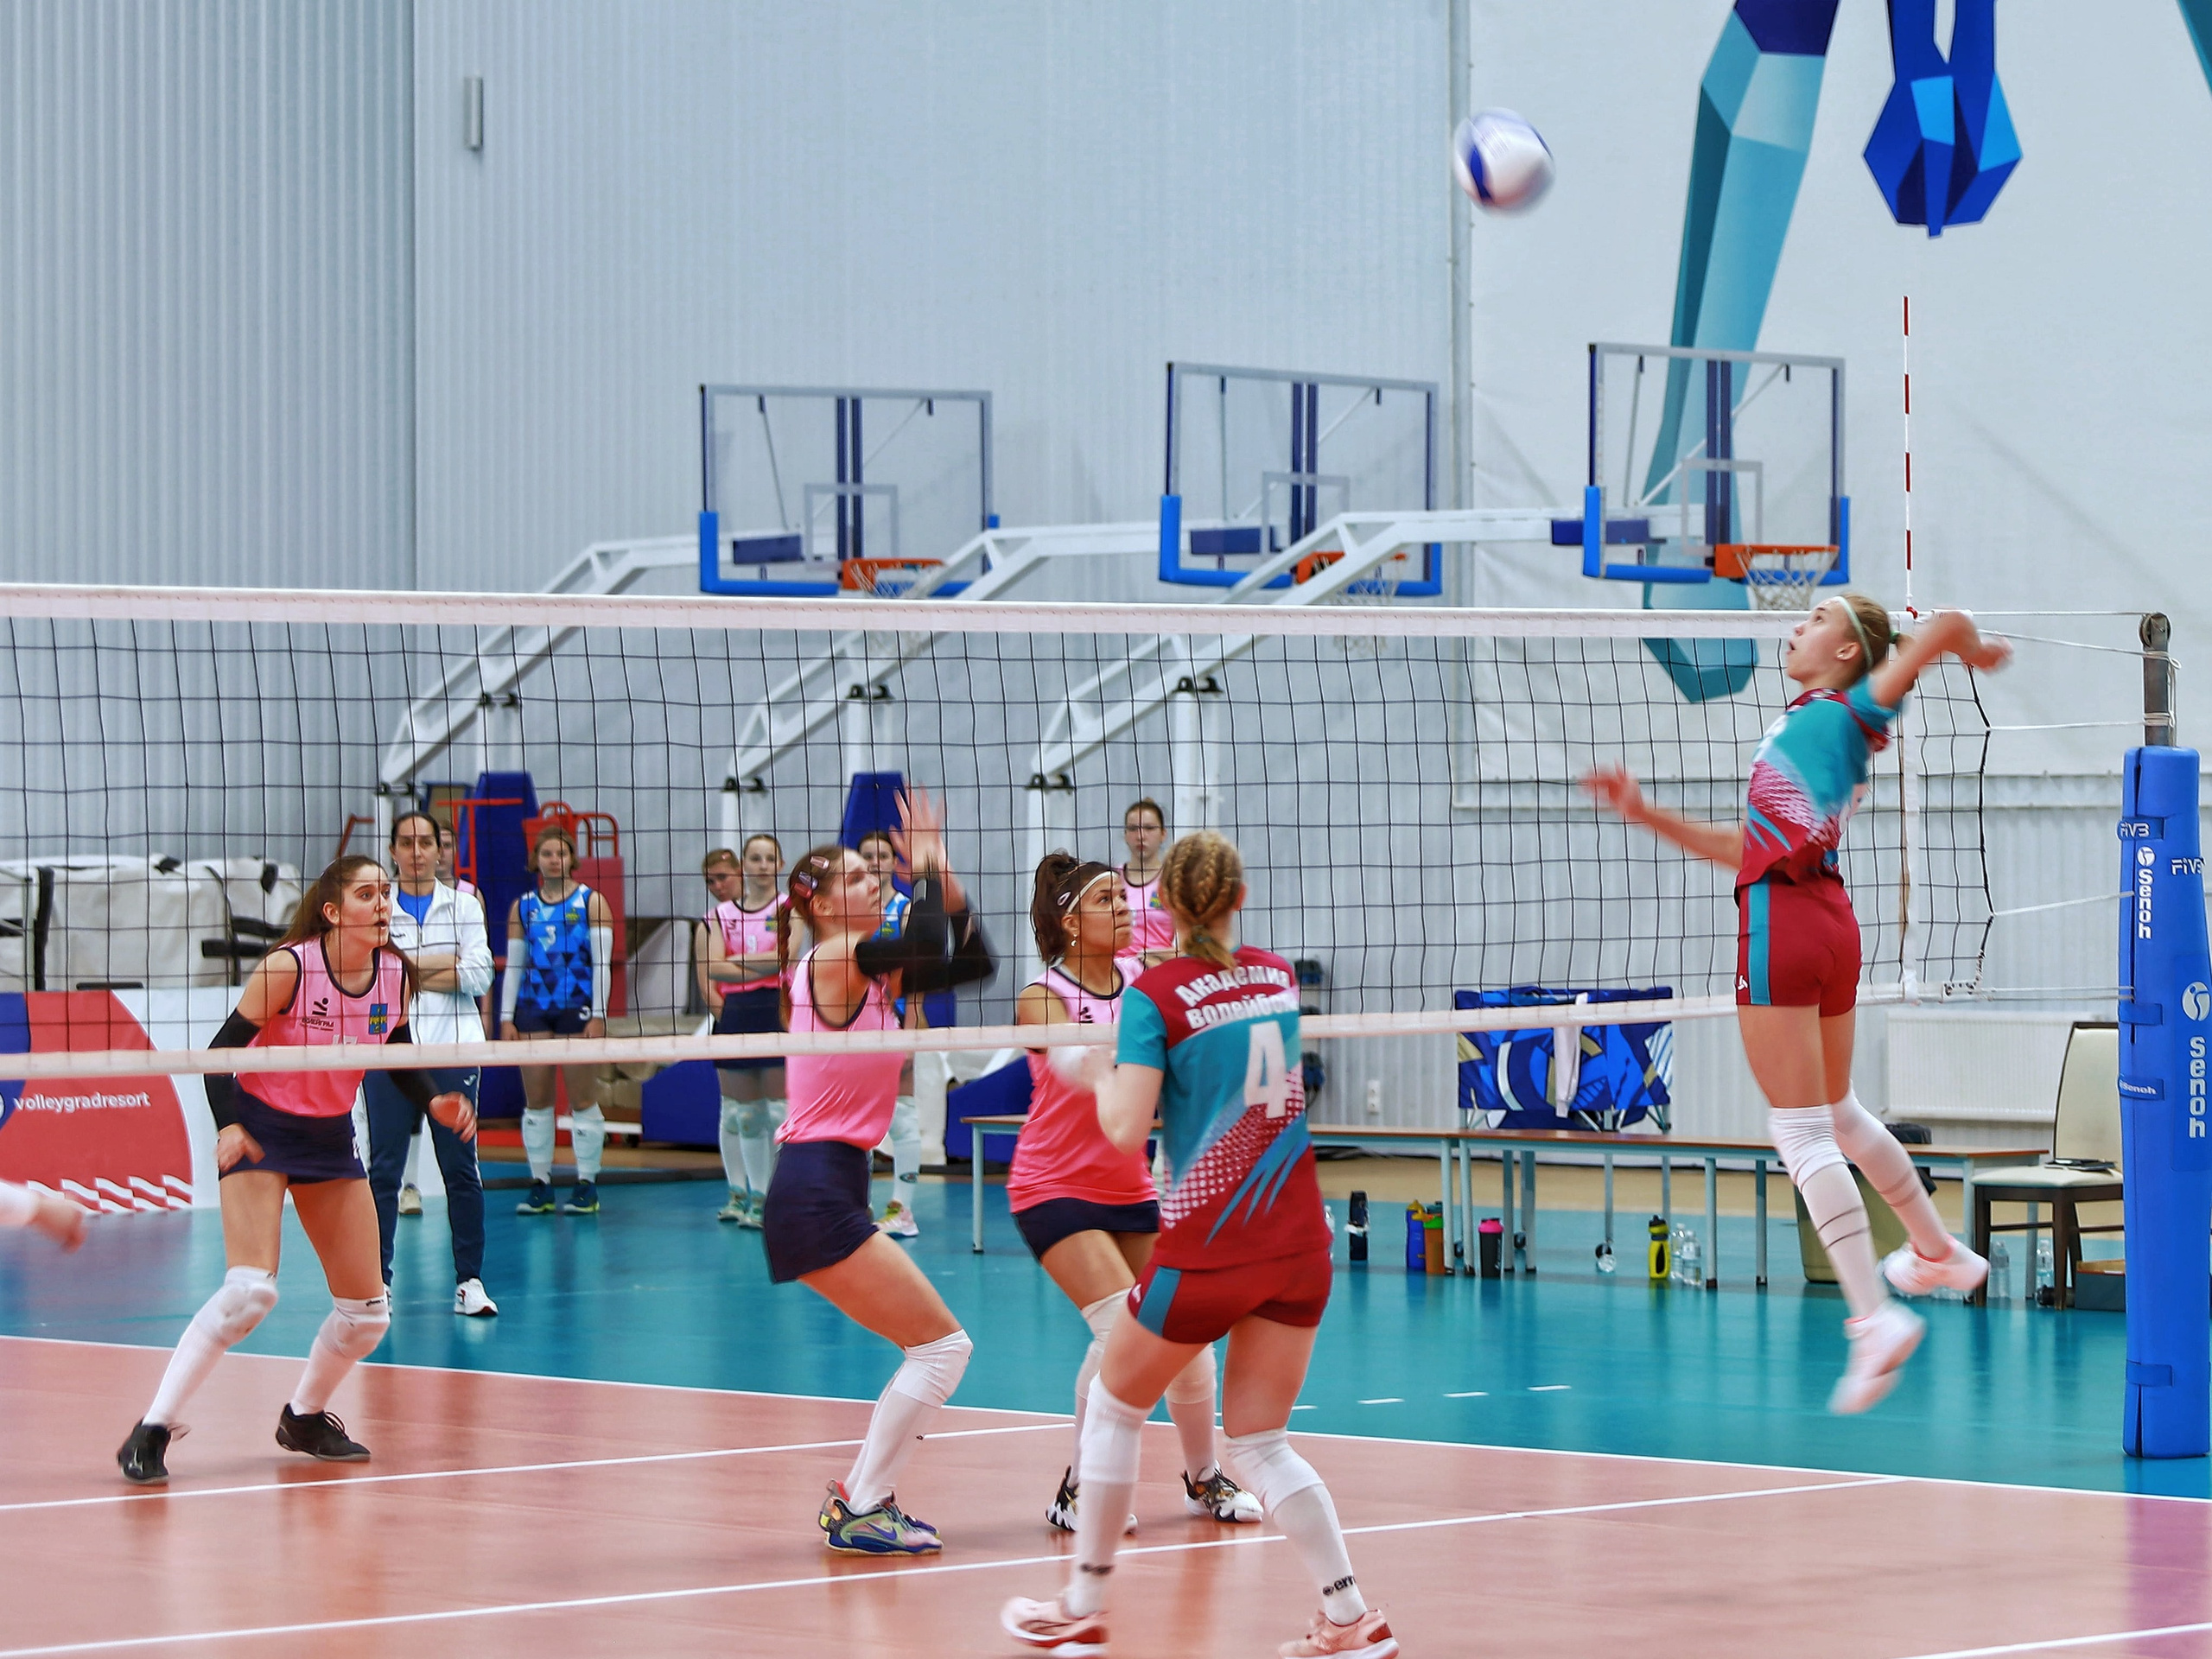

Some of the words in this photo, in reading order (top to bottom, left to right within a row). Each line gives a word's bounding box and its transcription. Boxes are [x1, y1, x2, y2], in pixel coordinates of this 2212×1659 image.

[2138, 868, 2153, 939] Senoh
[13, 1091, 151, 1113] volleygradresort
[1244, 1020, 1287, 1119] 4
[2190, 1036, 2206, 1138] Senoh
